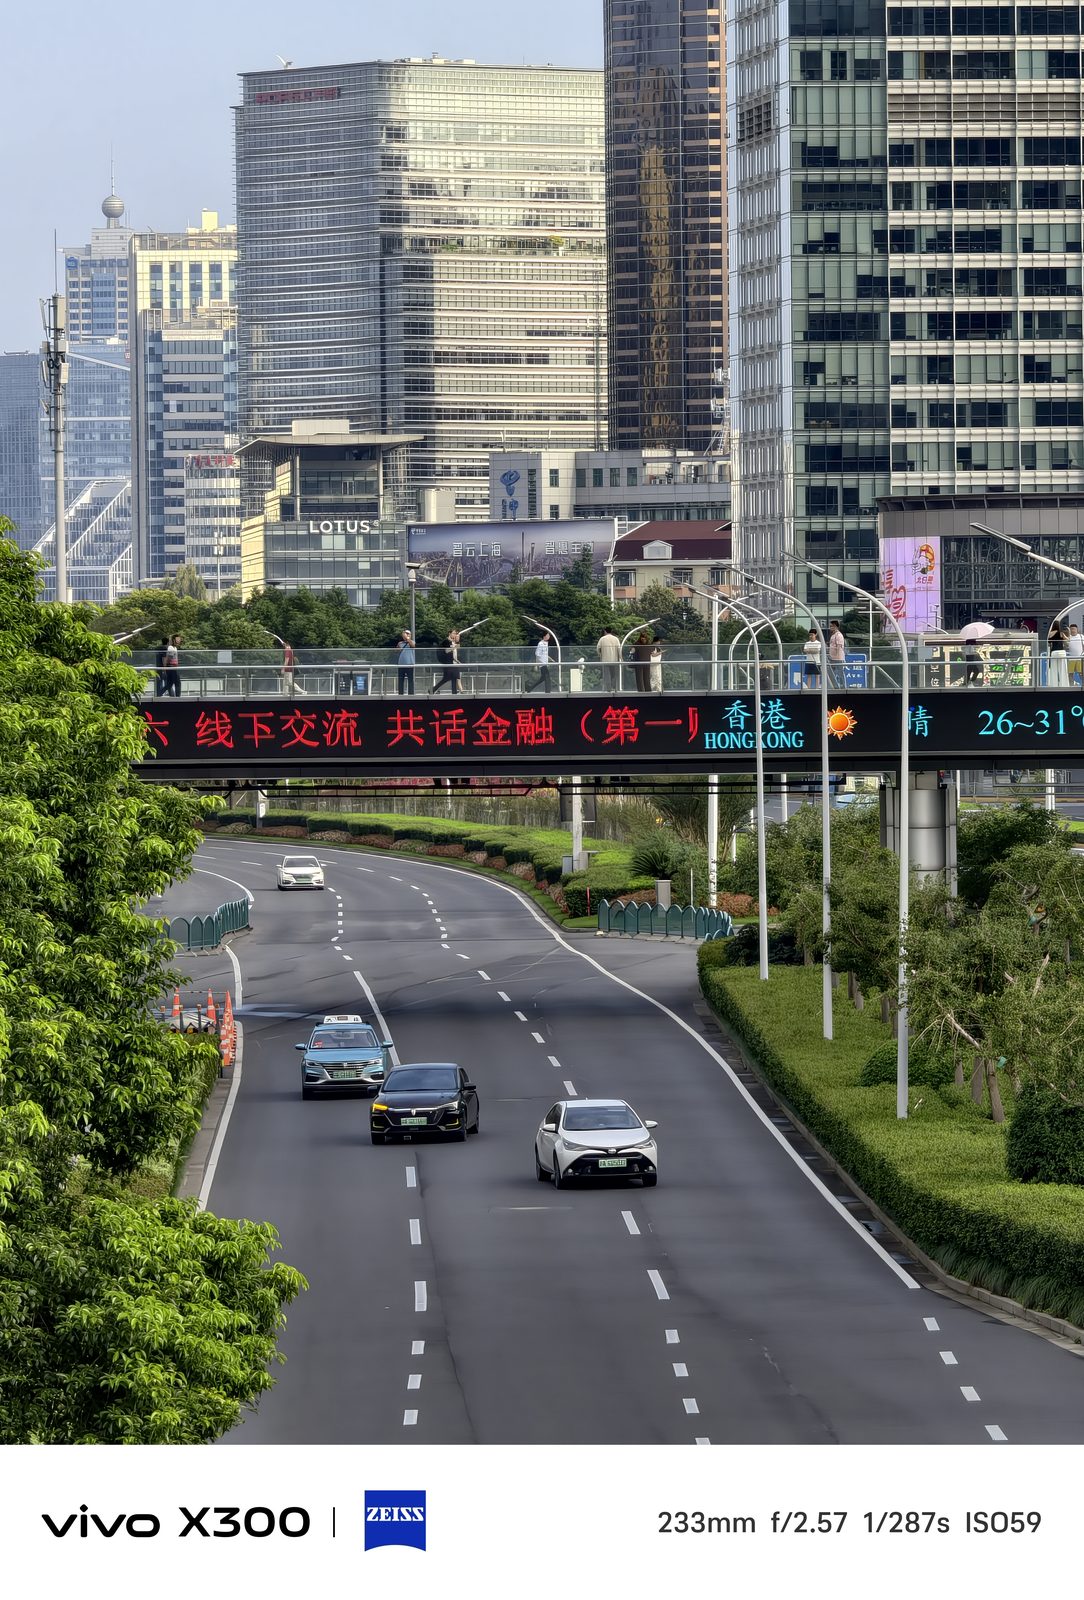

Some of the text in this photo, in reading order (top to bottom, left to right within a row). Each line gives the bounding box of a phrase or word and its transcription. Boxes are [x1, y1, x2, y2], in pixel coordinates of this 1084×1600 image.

[452, 541, 501, 557] 智云上海
[195, 710, 361, 748] 线下交流
[722, 699, 791, 730] 香港
[979, 706, 1084, 734] 26~31°
